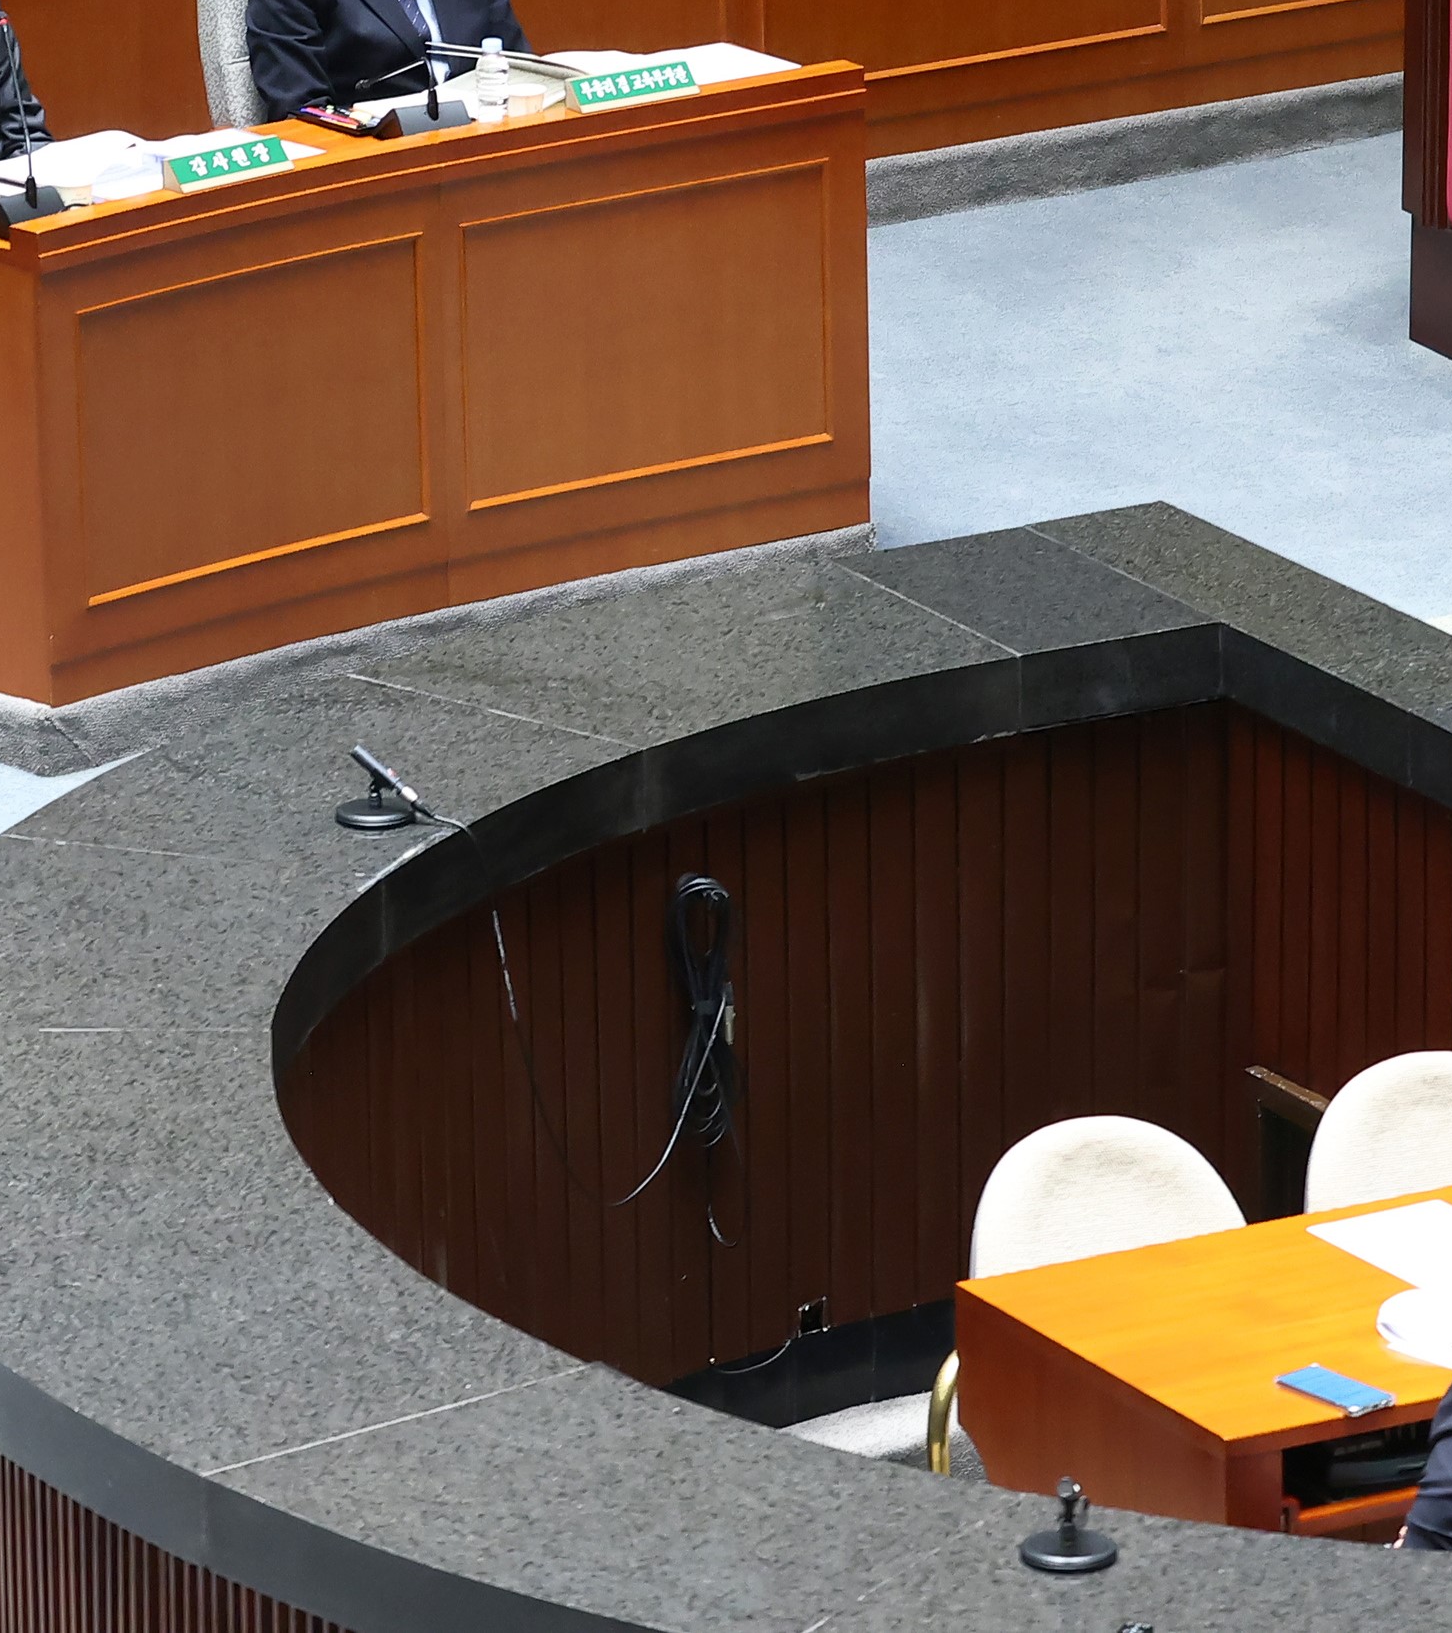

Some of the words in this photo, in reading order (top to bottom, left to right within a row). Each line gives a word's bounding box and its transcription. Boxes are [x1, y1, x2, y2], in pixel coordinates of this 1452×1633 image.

[580, 79, 618, 101] 부총리
[630, 64, 689, 90] 교육부장관
[188, 142, 272, 177] 감사원장
